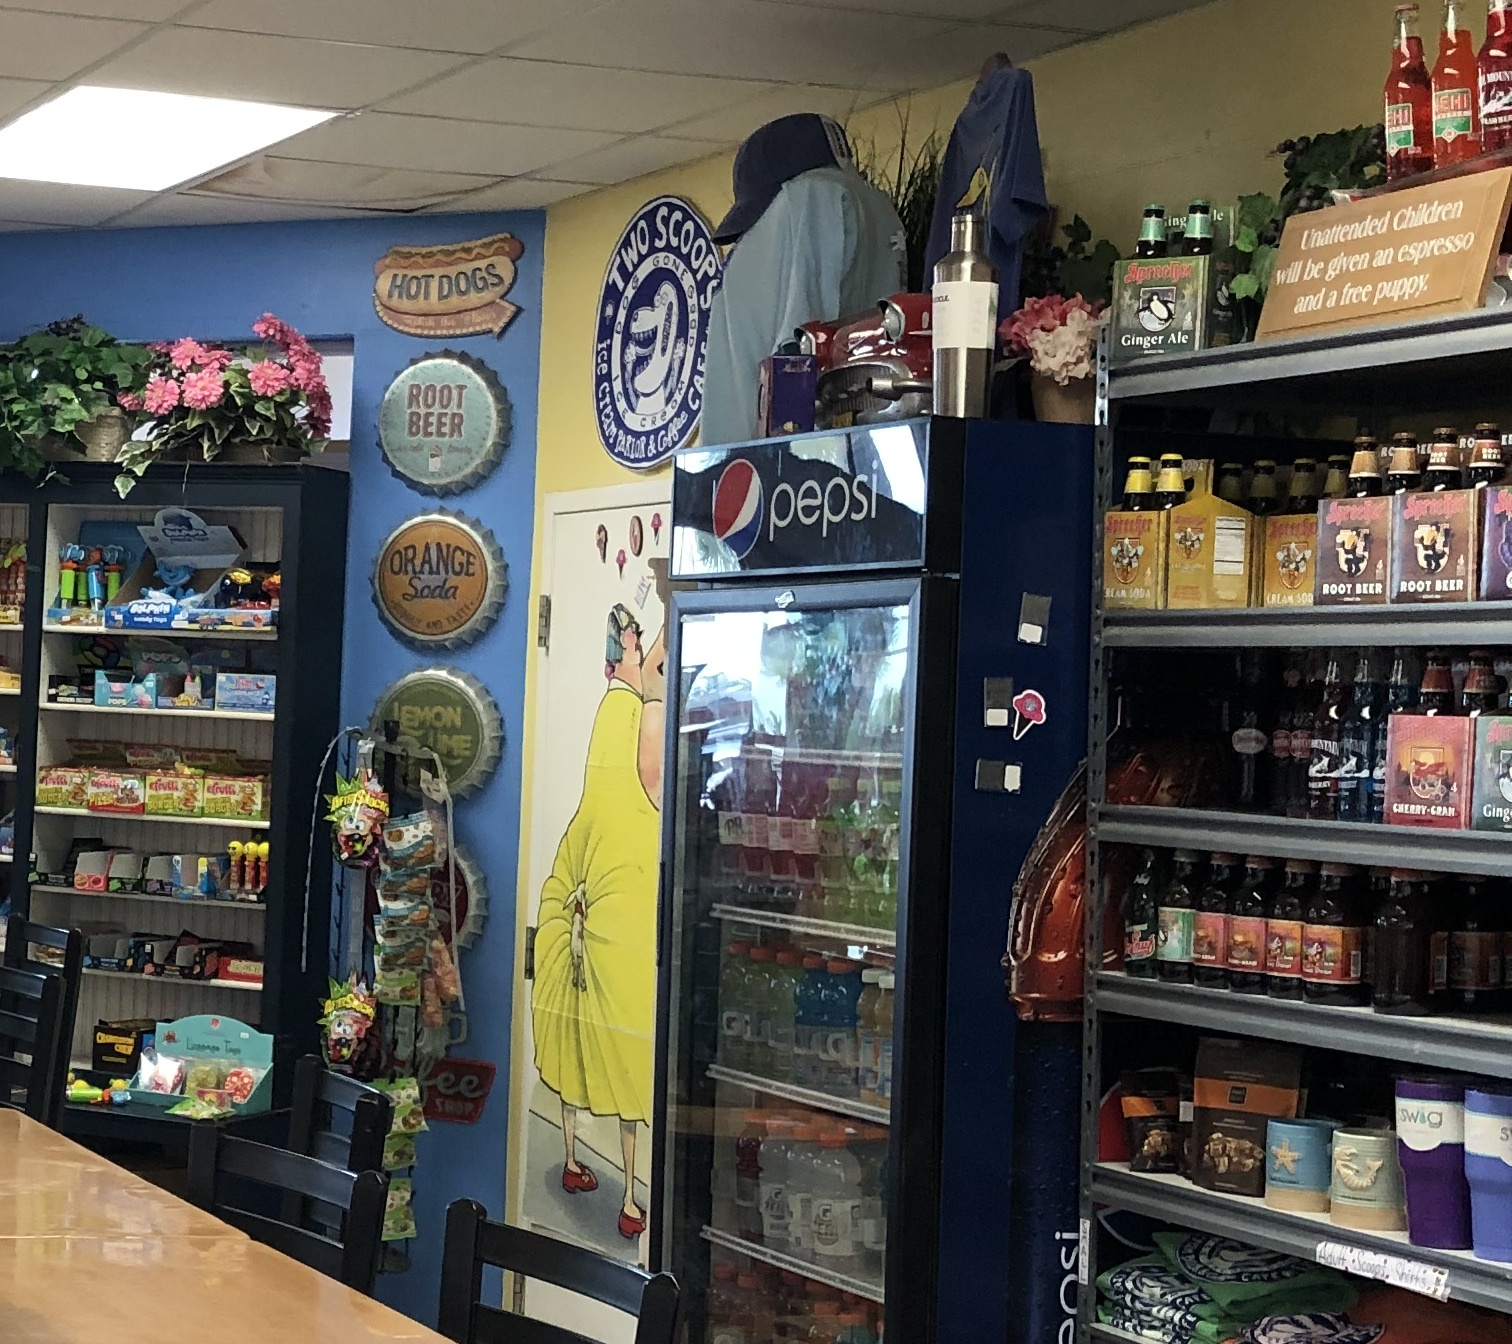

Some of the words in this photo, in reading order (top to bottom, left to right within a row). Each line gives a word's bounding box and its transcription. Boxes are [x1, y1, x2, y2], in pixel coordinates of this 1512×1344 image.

[1300, 209, 1391, 251] Unattended
[1393, 199, 1464, 232] Children
[608, 219, 650, 293] TWO
[1276, 260, 1301, 286] will
[1303, 258, 1325, 282] be
[1325, 251, 1370, 282] given
[1372, 246, 1395, 266] an
[1397, 231, 1475, 265] espresso
[388, 273, 434, 301] HOT
[438, 263, 505, 301] DOGS
[1293, 288, 1326, 314] and
[1326, 288, 1337, 307] a
[1339, 282, 1372, 307] free
[1373, 272, 1429, 305] puppy.
[1121, 334, 1164, 349] Ginger
[1167, 331, 1189, 345] Ale
[408, 383, 467, 410] ROOT
[408, 411, 464, 439] BEER
[769, 461, 878, 542] pepsi
[390, 541, 477, 577] ORANGE
[402, 575, 459, 602] Soda
[1297, 592, 1313, 605] SOD
[1322, 583, 1353, 595] ROOT
[1356, 583, 1383, 594] BEER
[1400, 580, 1432, 593] ROOT
[1435, 579, 1464, 592] BEER
[129, 602, 172, 615] DOLPHIN
[185, 1038, 220, 1054] Luggage
[1318, 1243, 1347, 1266] Adult
[1352, 1250, 1387, 1278] Scoops
[1395, 1263, 1427, 1288] Shirts
